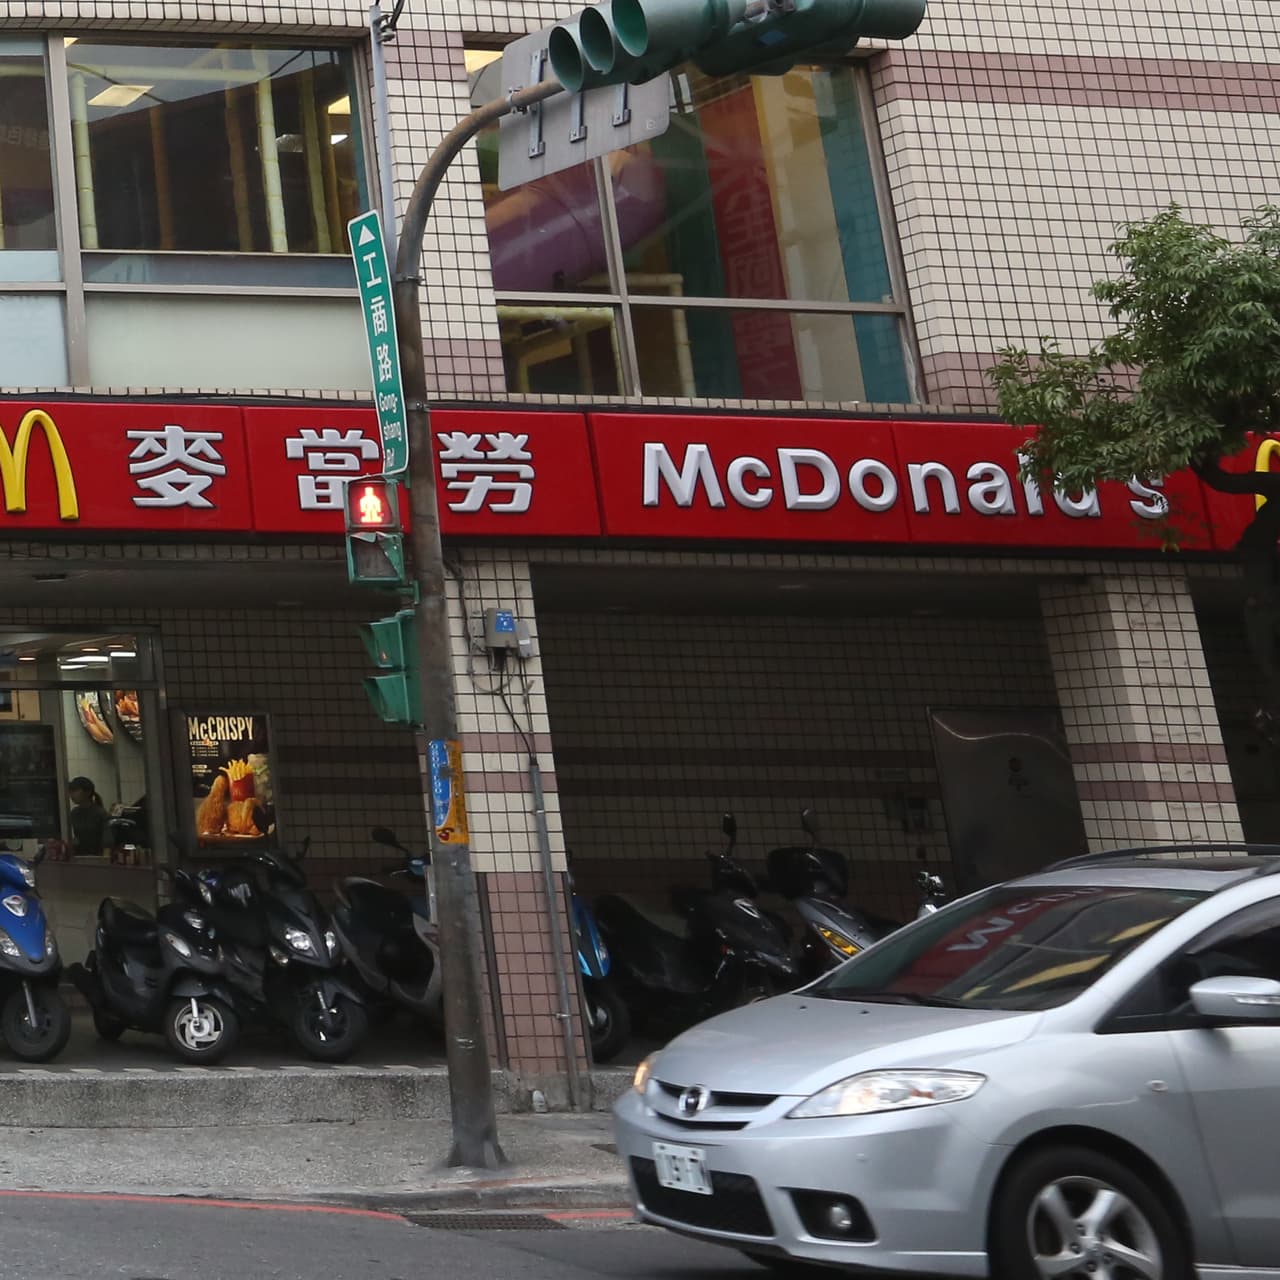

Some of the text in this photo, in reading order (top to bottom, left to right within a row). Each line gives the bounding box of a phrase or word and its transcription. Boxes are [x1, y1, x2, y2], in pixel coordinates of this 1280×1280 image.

[363, 251, 392, 383] 工商路
[125, 424, 536, 514] 麥當勞
[187, 716, 253, 740] McCRISPY
